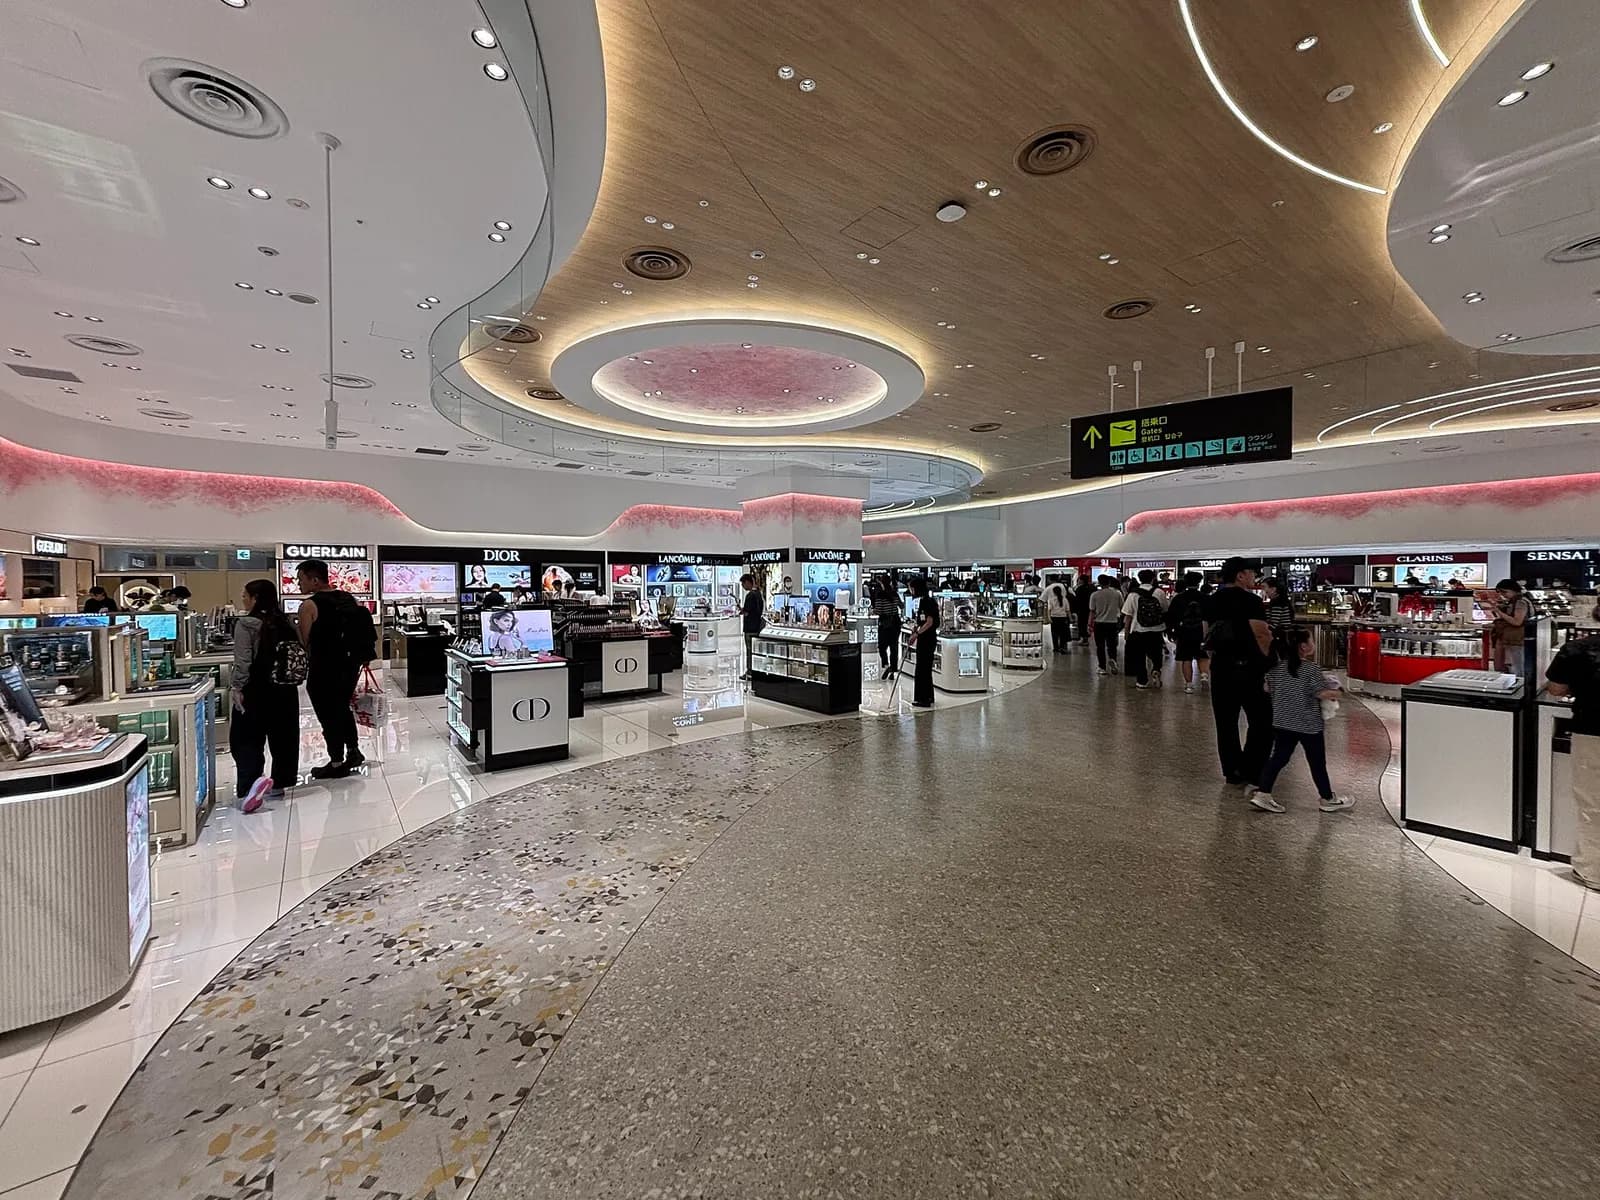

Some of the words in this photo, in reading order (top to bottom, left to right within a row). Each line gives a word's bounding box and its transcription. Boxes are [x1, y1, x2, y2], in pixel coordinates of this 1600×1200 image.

[1141, 427, 1163, 436] Gates
[286, 545, 366, 558] GUERLAIN
[483, 549, 521, 562] DIOR
[808, 550, 844, 561] LANCÔME
[1527, 550, 1590, 561] SENSAI
[658, 554, 696, 564] LANCÔME
[1396, 554, 1454, 563] CLARINS
